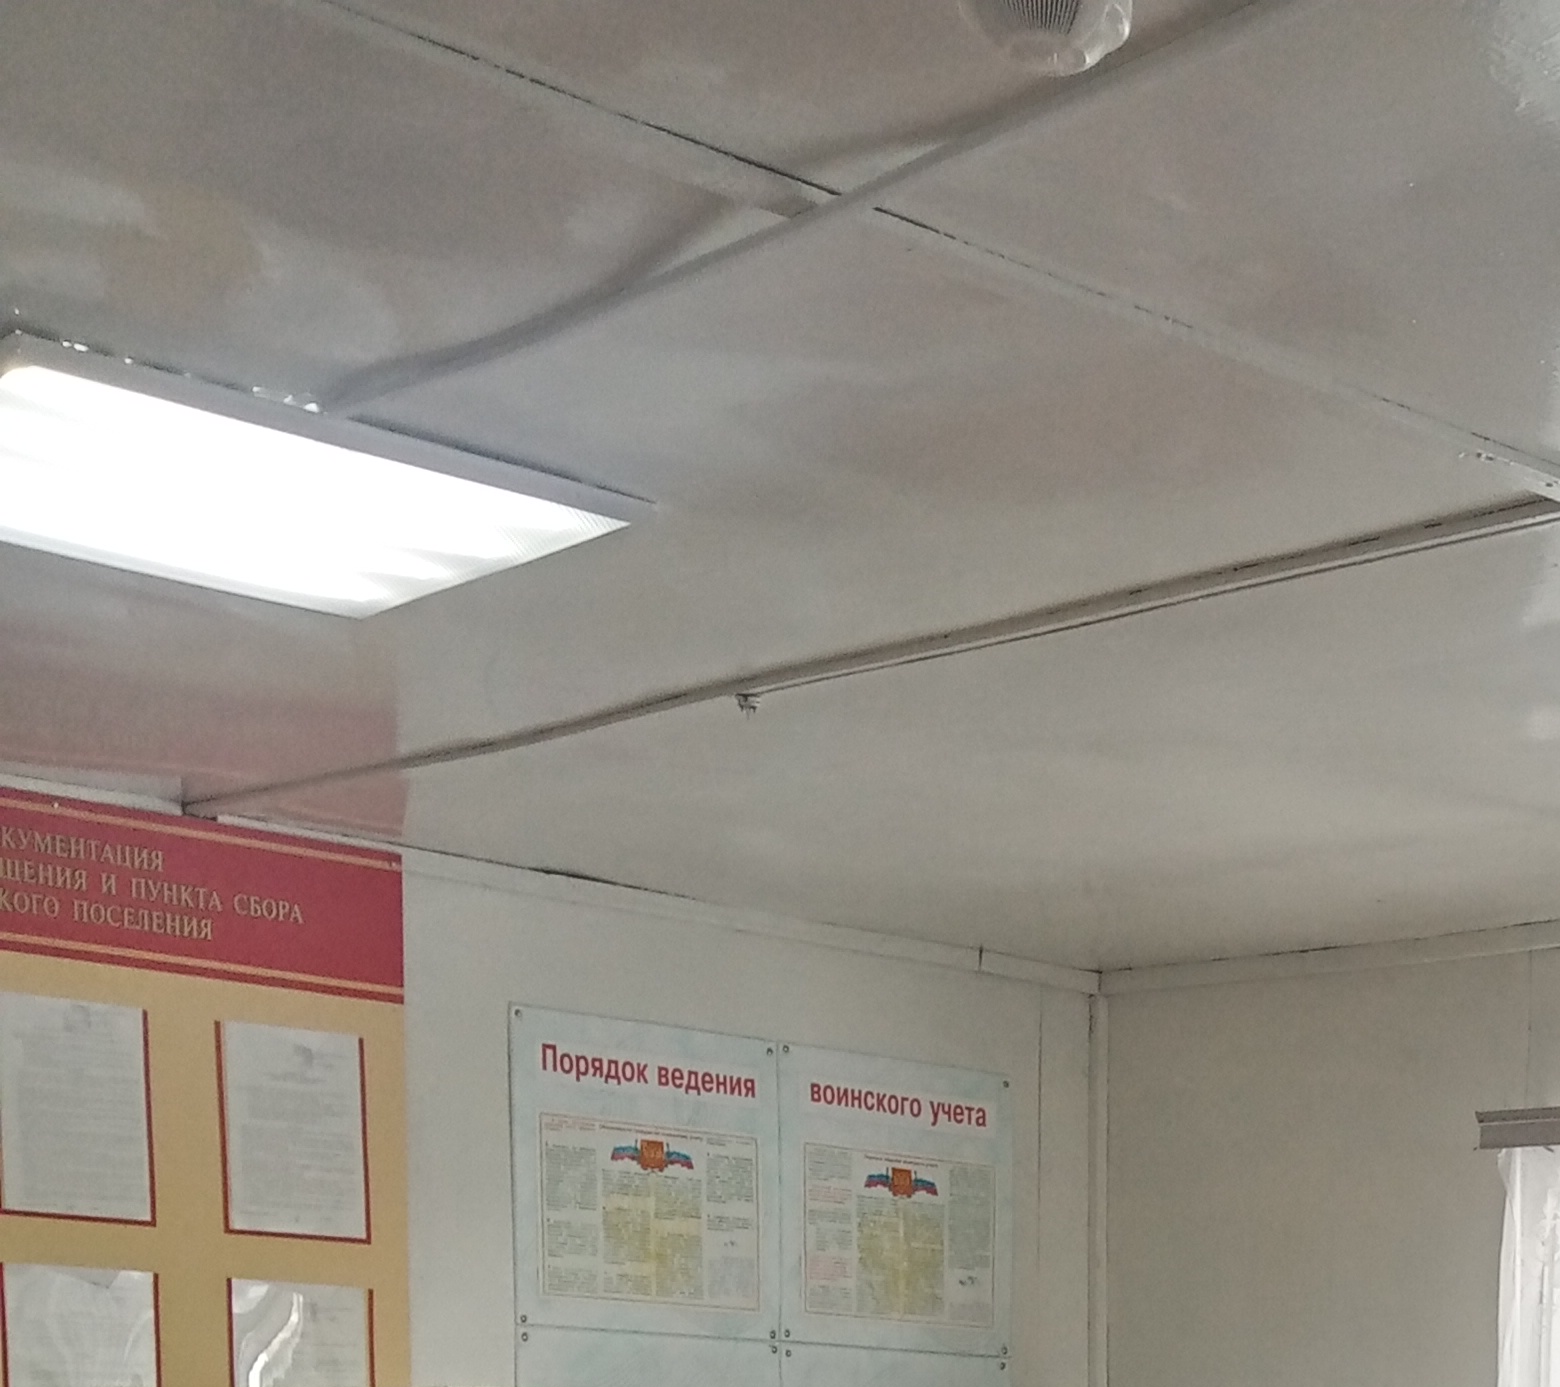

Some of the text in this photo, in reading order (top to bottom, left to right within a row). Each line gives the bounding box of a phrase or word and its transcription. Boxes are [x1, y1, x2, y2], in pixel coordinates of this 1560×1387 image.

[73, 899, 214, 941] ПОСЕЛЕНИЯ
[101, 872, 118, 896] И
[130, 877, 223, 912] ПУНКТА
[233, 893, 305, 925] СБОРА
[541, 1043, 987, 1127] Порядок ведения воинского учета
